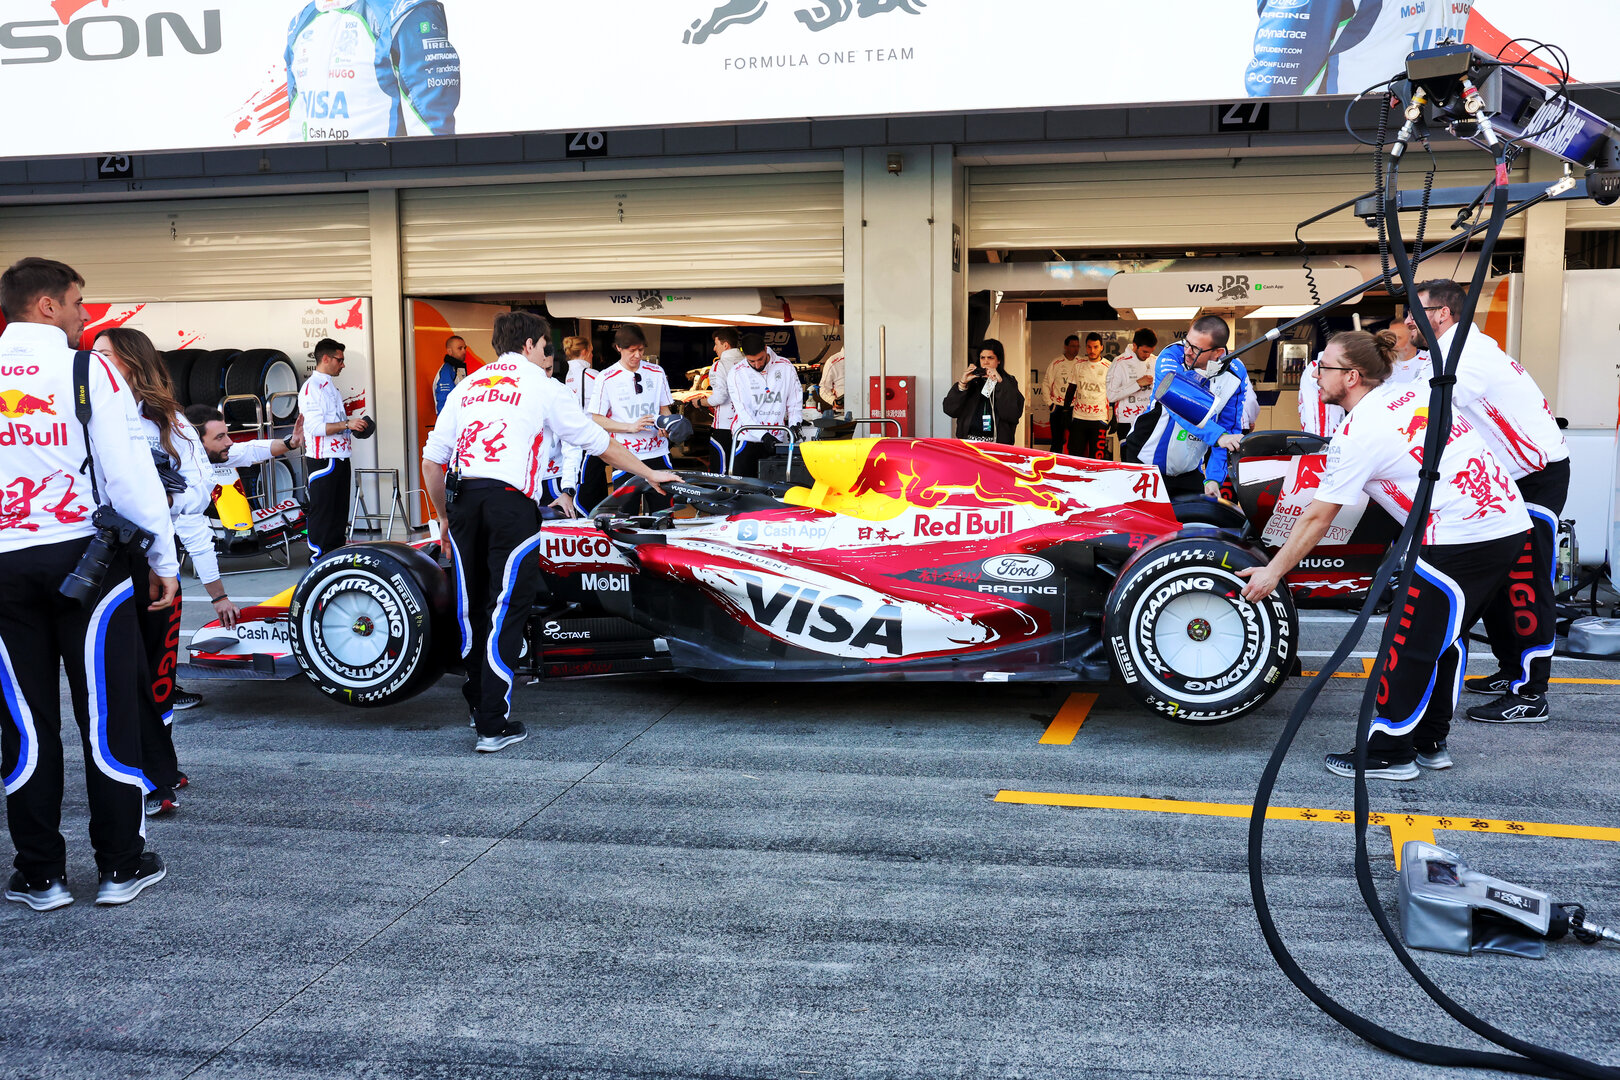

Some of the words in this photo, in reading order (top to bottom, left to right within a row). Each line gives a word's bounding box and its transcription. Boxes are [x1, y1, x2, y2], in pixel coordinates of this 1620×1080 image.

[1261, 12, 1310, 20] RACING
[1401, 2, 1426, 18] Mobil
[0, 9, 223, 65] SON
[422, 37, 454, 50] PIREL
[724, 54, 808, 70] FORMULA
[818, 51, 855, 65] ONE
[865, 47, 914, 62] TEAM
[328, 69, 355, 79] HUGO
[1256, 74, 1298, 85] OCTAVE
[300, 91, 350, 119] VISA
[328, 128, 349, 140] App
[1520, 97, 1586, 156] Airtasker
[1187, 283, 1214, 293] VISA
[610, 295, 633, 304] VISA
[304, 328, 328, 338] VISA
[486, 363, 517, 371] HUGO
[1079, 381, 1101, 393] VISA
[461, 390, 488, 408] Red
[488, 389, 522, 406] Bull
[753, 391, 782, 405] VISA
[1387, 391, 1416, 411] HUGO
[623, 402, 656, 419] VISA
[15, 422, 68, 446] Bull
[1095, 429, 1107, 460] HUG
[1132, 473, 1159, 498] 41
[255, 500, 295, 518] HUGO
[1275, 502, 1292, 516] Red
[763, 525, 797, 537] Cash
[799, 525, 827, 539] App
[914, 512, 961, 537] Red
[966, 511, 1013, 535] Bull
[1264, 527, 1292, 539] EDITIO
[1270, 514, 1352, 541] CHRY
[858, 526, 905, 541] 日本
[546, 538, 611, 558] HUGO
[711, 546, 792, 571] CONFLUENT
[996, 557, 1040, 577] Ford
[1299, 559, 1345, 568] HUGO
[581, 573, 631, 592] Mobil
[978, 584, 1058, 595] RACING
[390, 573, 421, 615] PIRELLI
[321, 578, 403, 638] XMTRADING
[732, 570, 904, 655] VISA
[237, 626, 269, 640] Cash
[271, 627, 289, 643] Ap
[1140, 577, 1215, 675] XMTRADING
[552, 631, 591, 640] OCTAVE
[1184, 594, 1260, 691] XMTRADING
[152, 594, 182, 703] HUGO
[313, 620, 395, 679] XMTRADING
[1111, 635, 1138, 684] PIRELLI
[1325, 756, 1354, 770] HUGO
